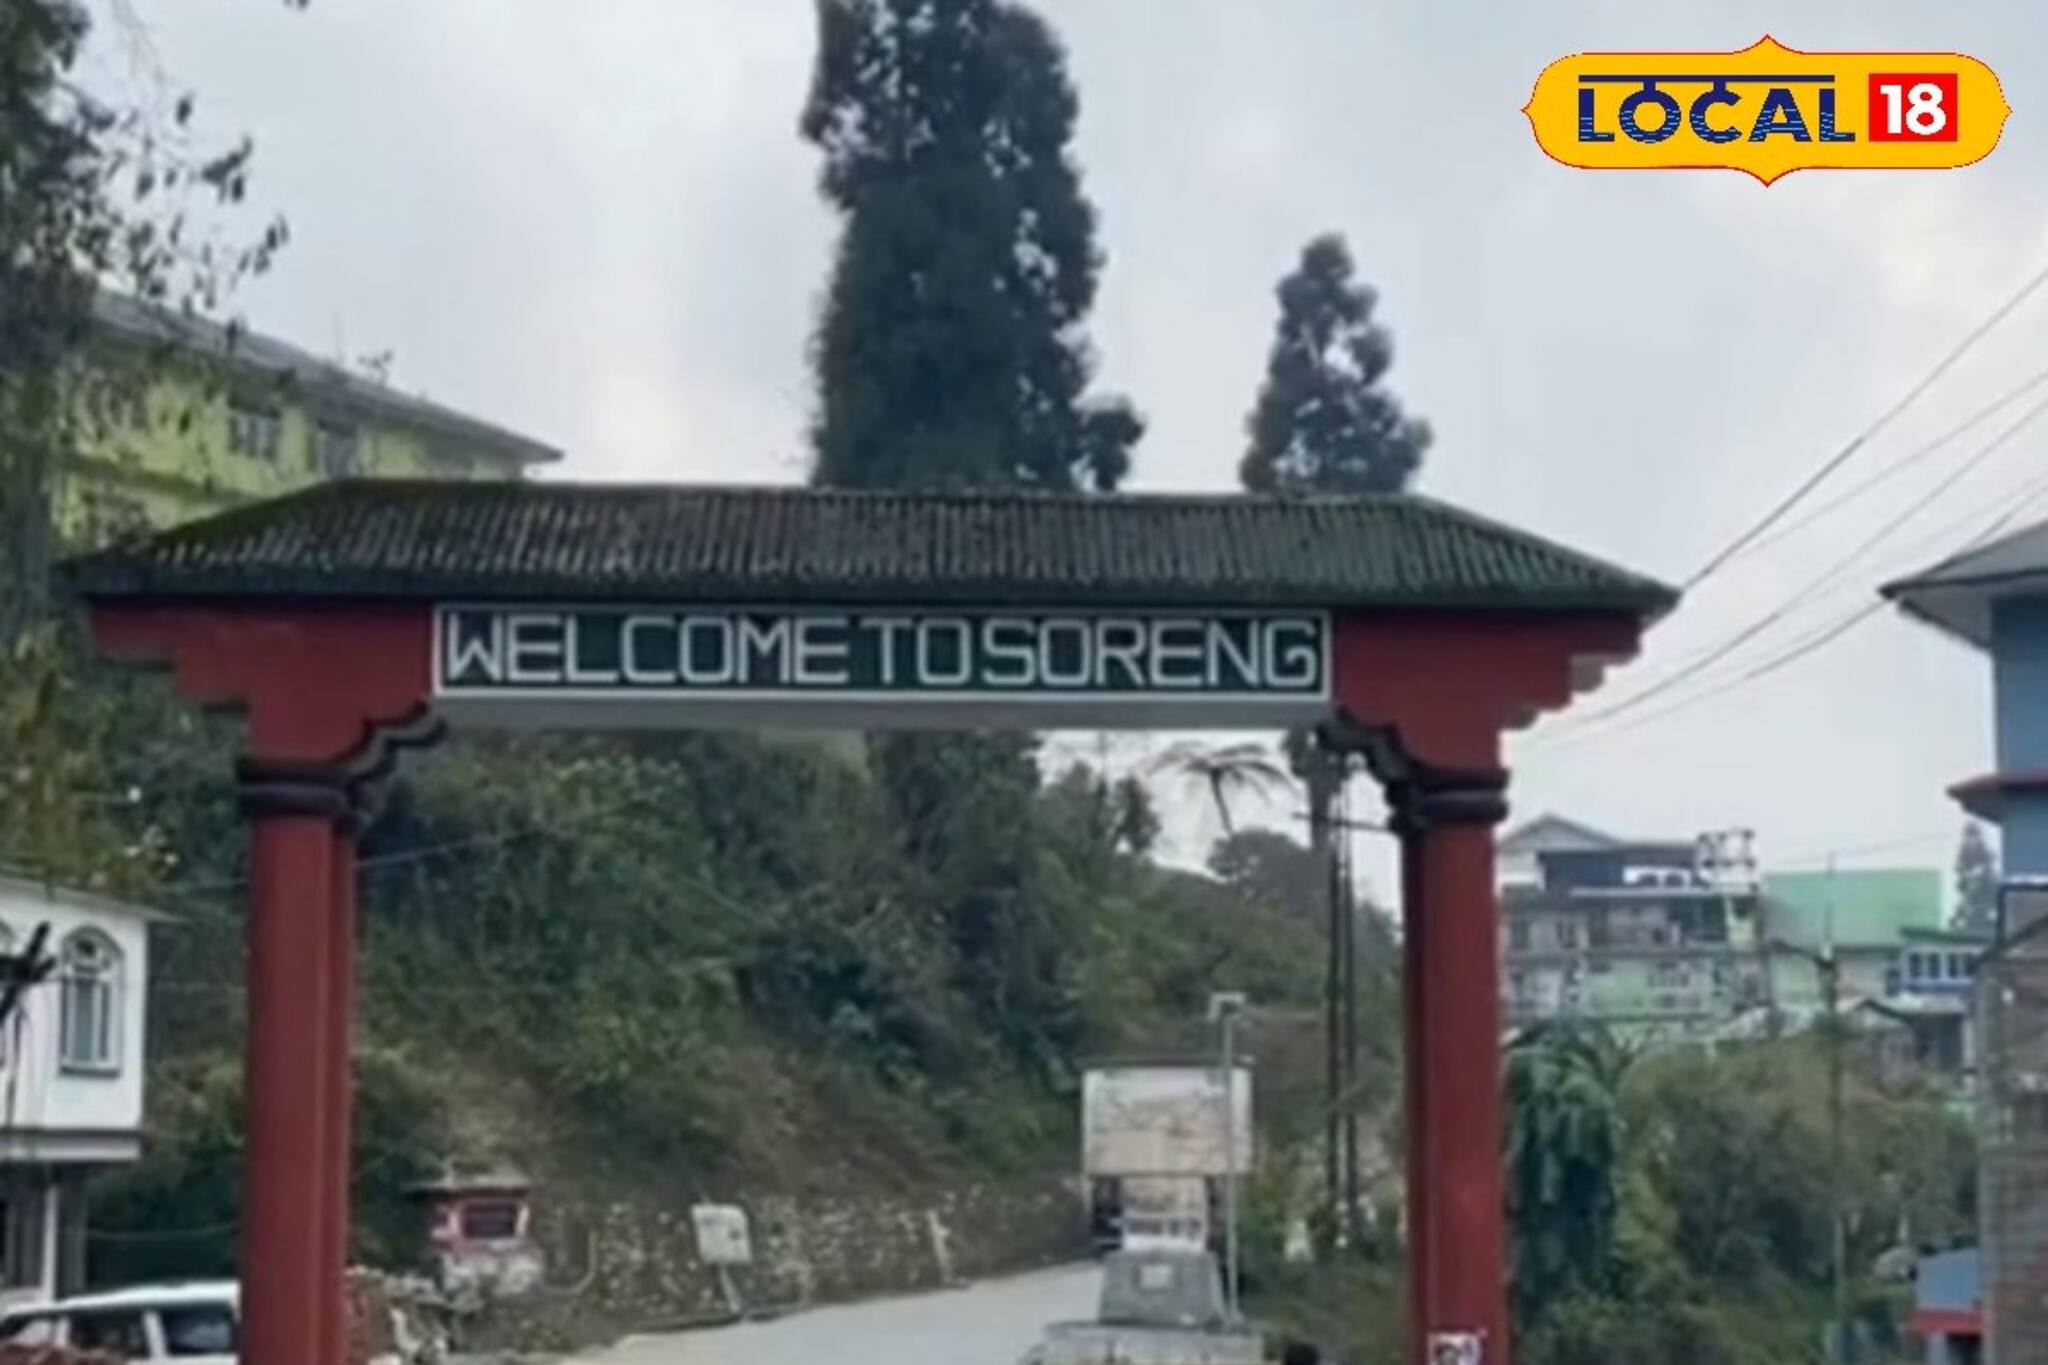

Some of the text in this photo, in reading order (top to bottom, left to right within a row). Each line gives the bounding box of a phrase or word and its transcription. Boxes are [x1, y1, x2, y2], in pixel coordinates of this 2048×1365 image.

[447, 614, 1317, 687] WELCOME TO SORENG
